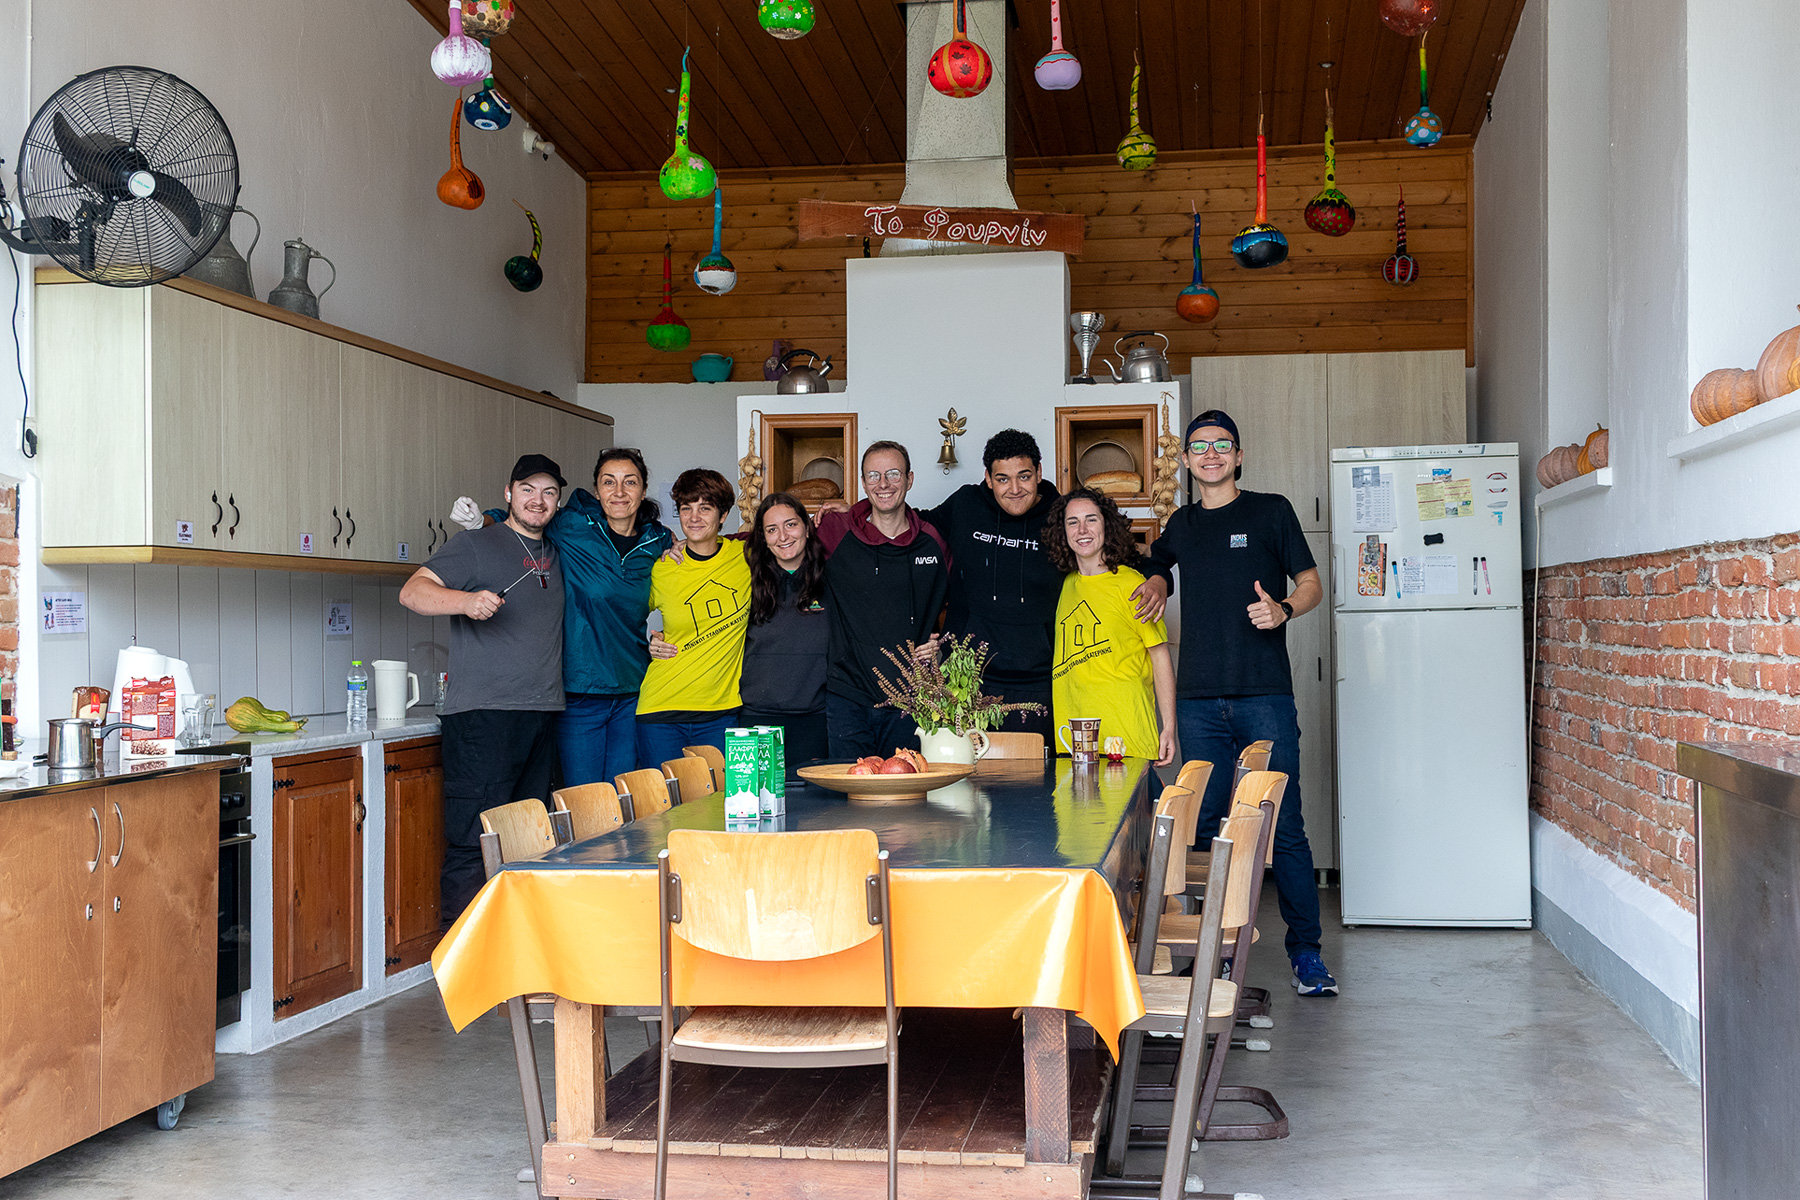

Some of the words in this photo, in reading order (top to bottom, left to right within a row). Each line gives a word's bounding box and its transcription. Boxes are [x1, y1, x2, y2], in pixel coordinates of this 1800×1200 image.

[865, 205, 904, 236] Το
[972, 531, 1039, 551] carhartt
[915, 555, 938, 565] NASA
[728, 752, 756, 762] ΓΑΛΑ
